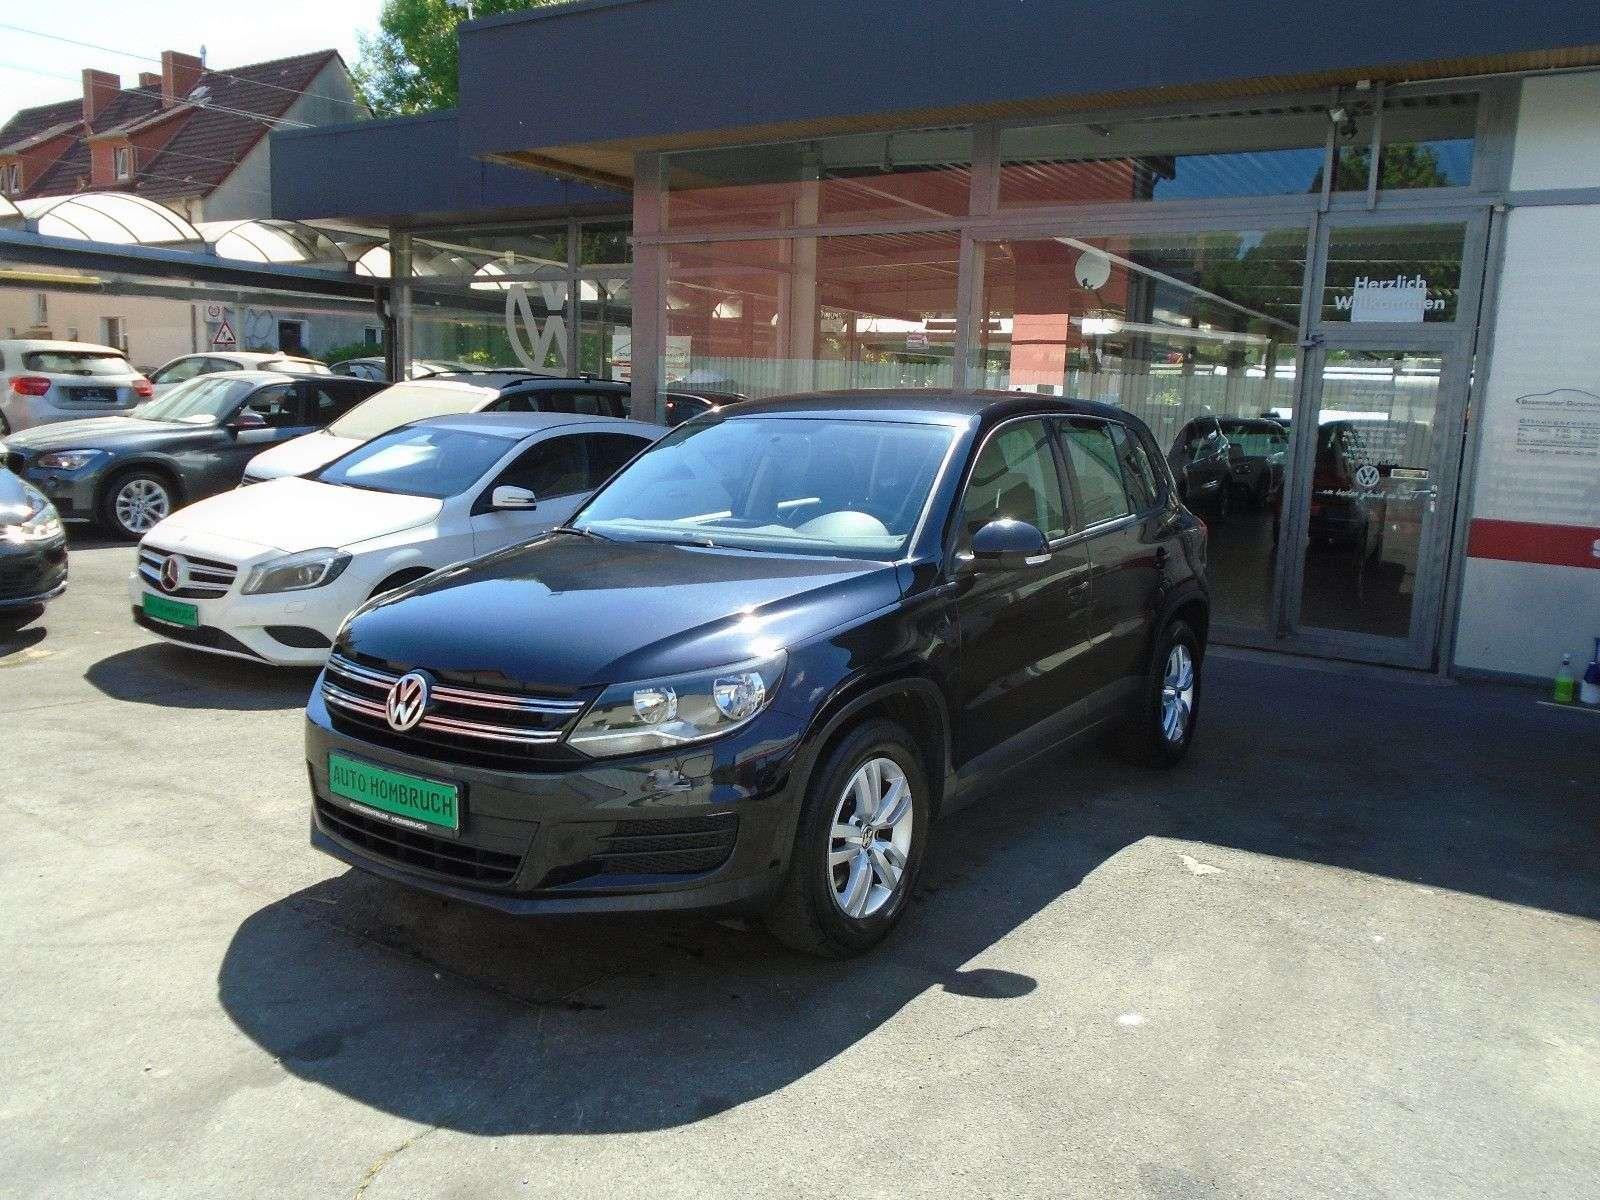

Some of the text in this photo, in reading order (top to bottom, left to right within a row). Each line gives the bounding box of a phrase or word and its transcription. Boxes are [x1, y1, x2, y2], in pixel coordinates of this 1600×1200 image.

[1354, 274, 1427, 289] Herzlich
[386, 673, 427, 731] VW
[332, 766, 367, 792] AUTO
[370, 777, 453, 816] HOMBRUCH
